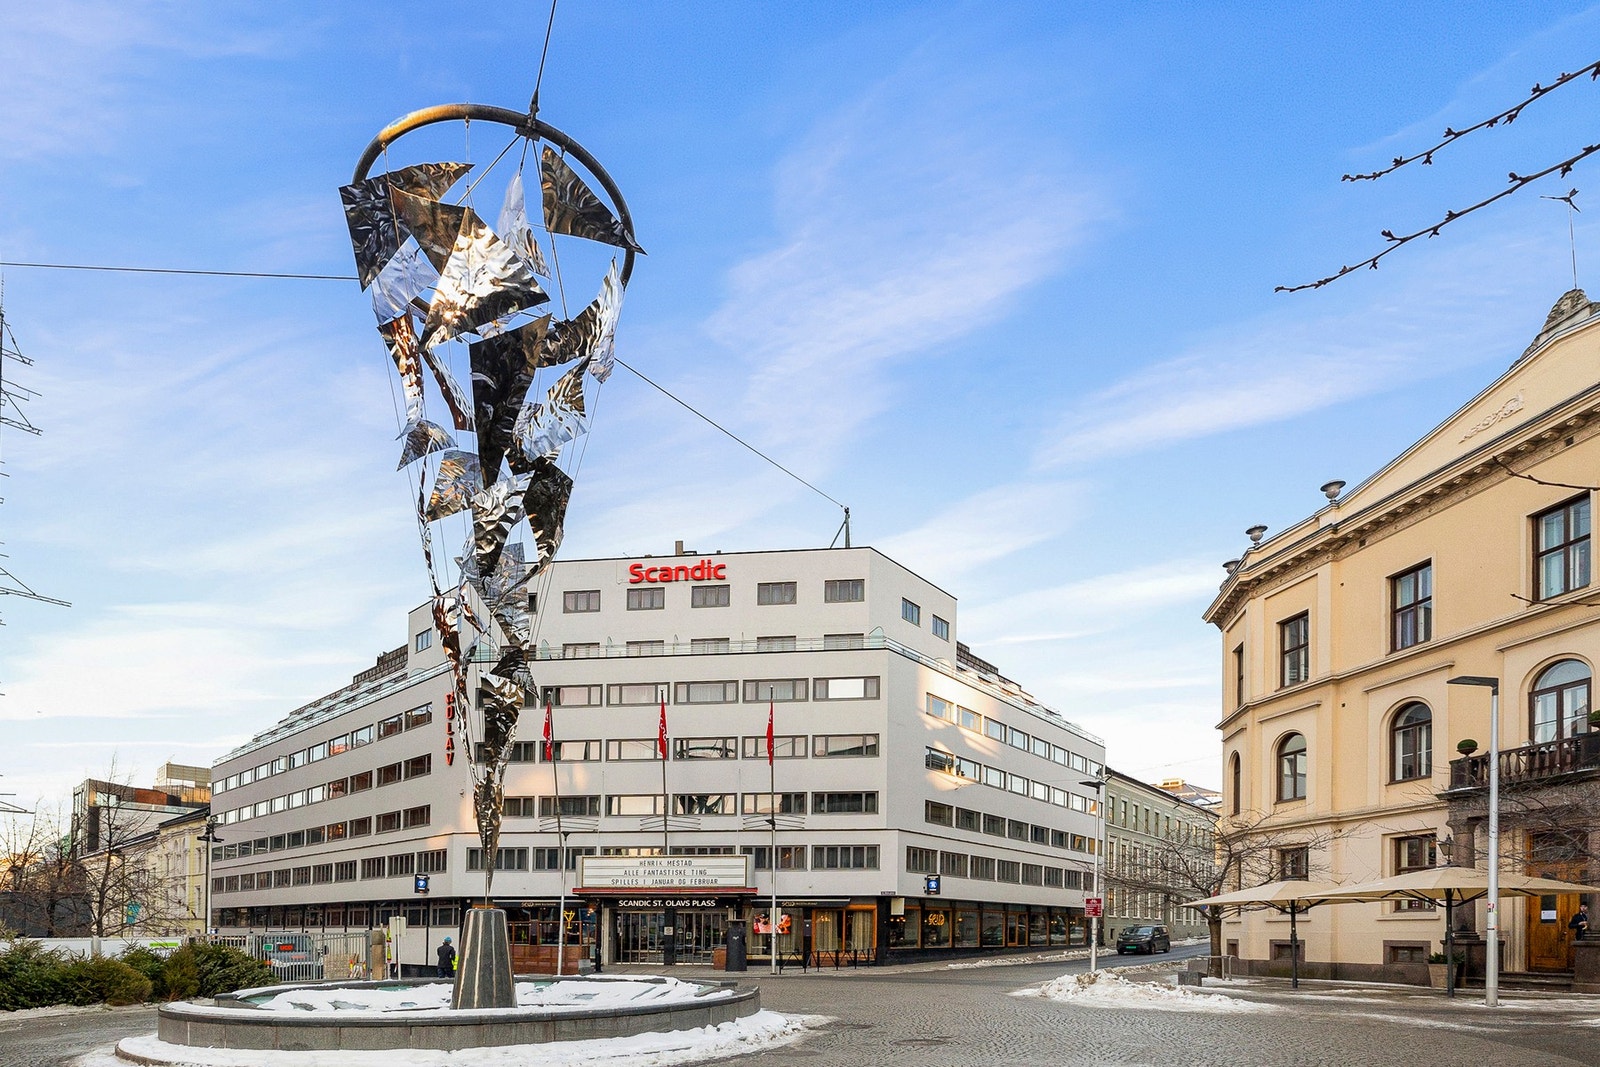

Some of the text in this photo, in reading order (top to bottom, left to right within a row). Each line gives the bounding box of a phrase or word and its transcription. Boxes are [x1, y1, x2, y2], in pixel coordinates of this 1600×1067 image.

[629, 559, 727, 584] Scandic
[446, 705, 455, 766] OLAV
[618, 899, 716, 907] SCANDIC ST. OLAVS PLASS
